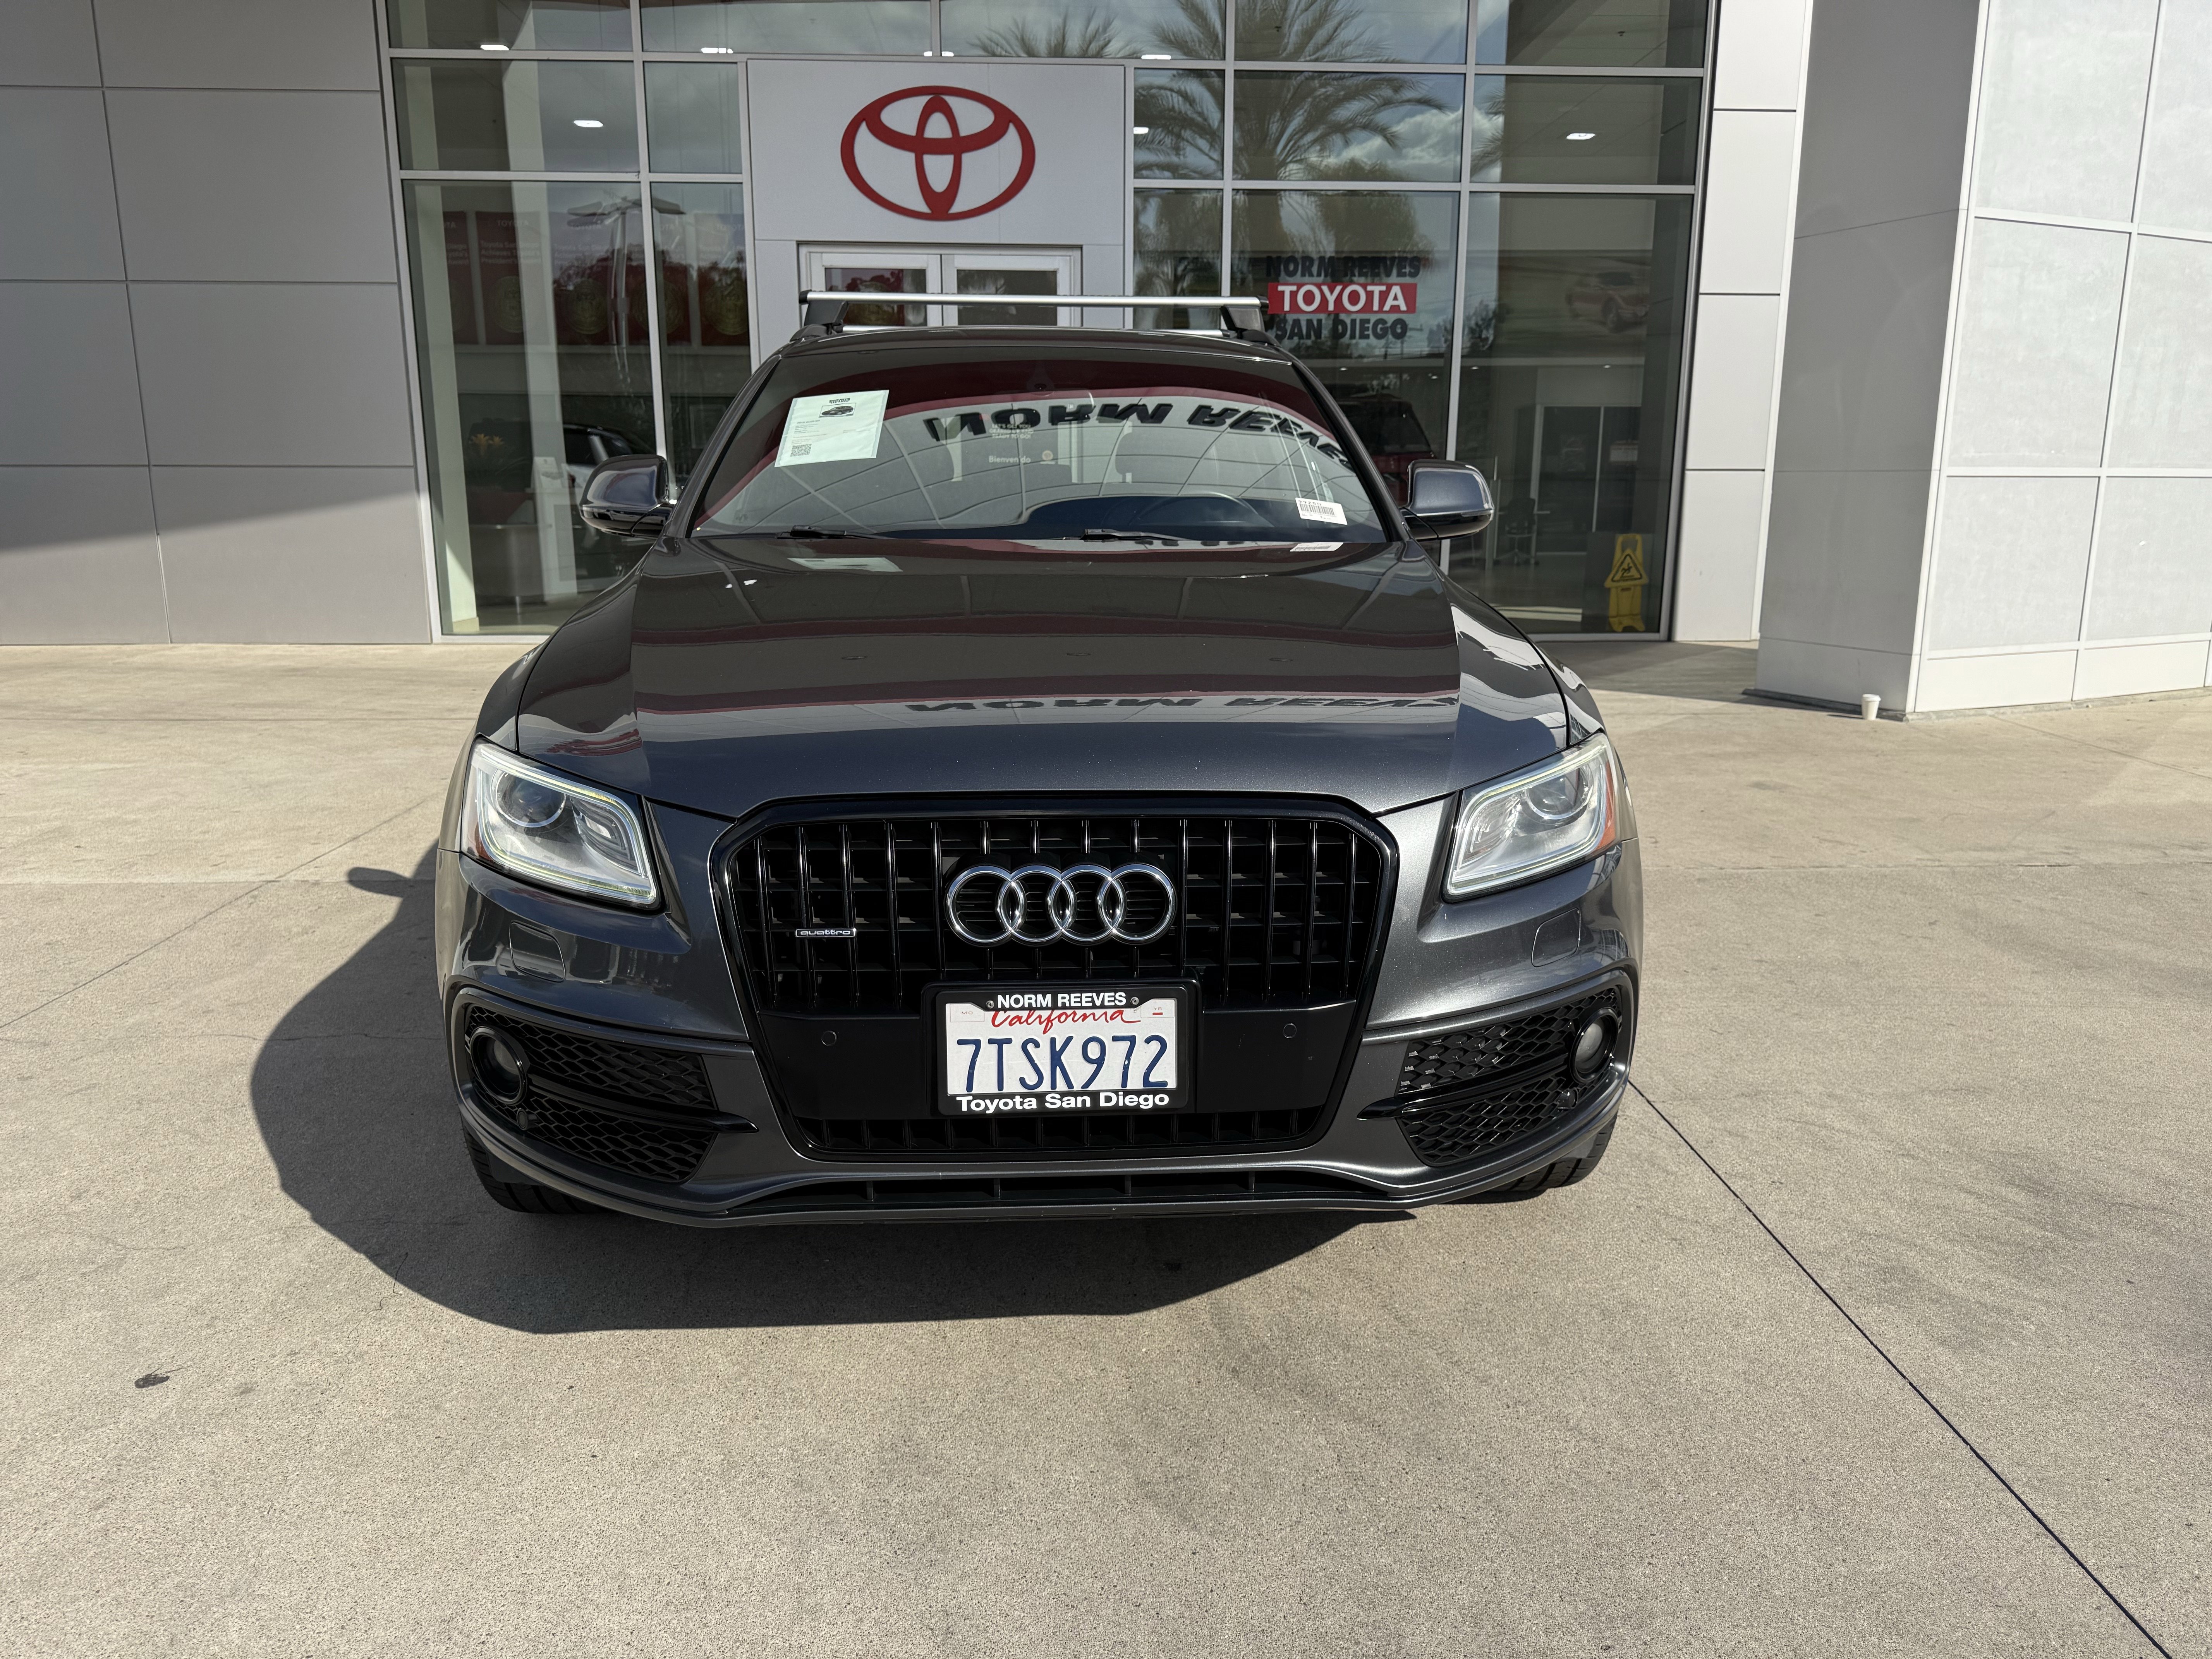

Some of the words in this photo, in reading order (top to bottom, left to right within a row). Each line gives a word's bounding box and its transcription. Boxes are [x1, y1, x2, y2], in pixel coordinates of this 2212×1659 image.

[1266, 256, 1336, 278] NORM
[1343, 256, 1420, 278] REEVES
[1278, 285, 1407, 312] TOYOTA
[1275, 318, 1322, 340] SAN
[1332, 318, 1408, 340] DIEGO
[997, 994, 1051, 1008] NORM
[1058, 992, 1127, 1006] REEVES
[991, 1009, 1141, 1034] California
[957, 1034, 1168, 1092] 7TSK972
[957, 1096, 1037, 1114] Toyota
[1045, 1093, 1091, 1108] San
[1099, 1092, 1170, 1110] Diego
